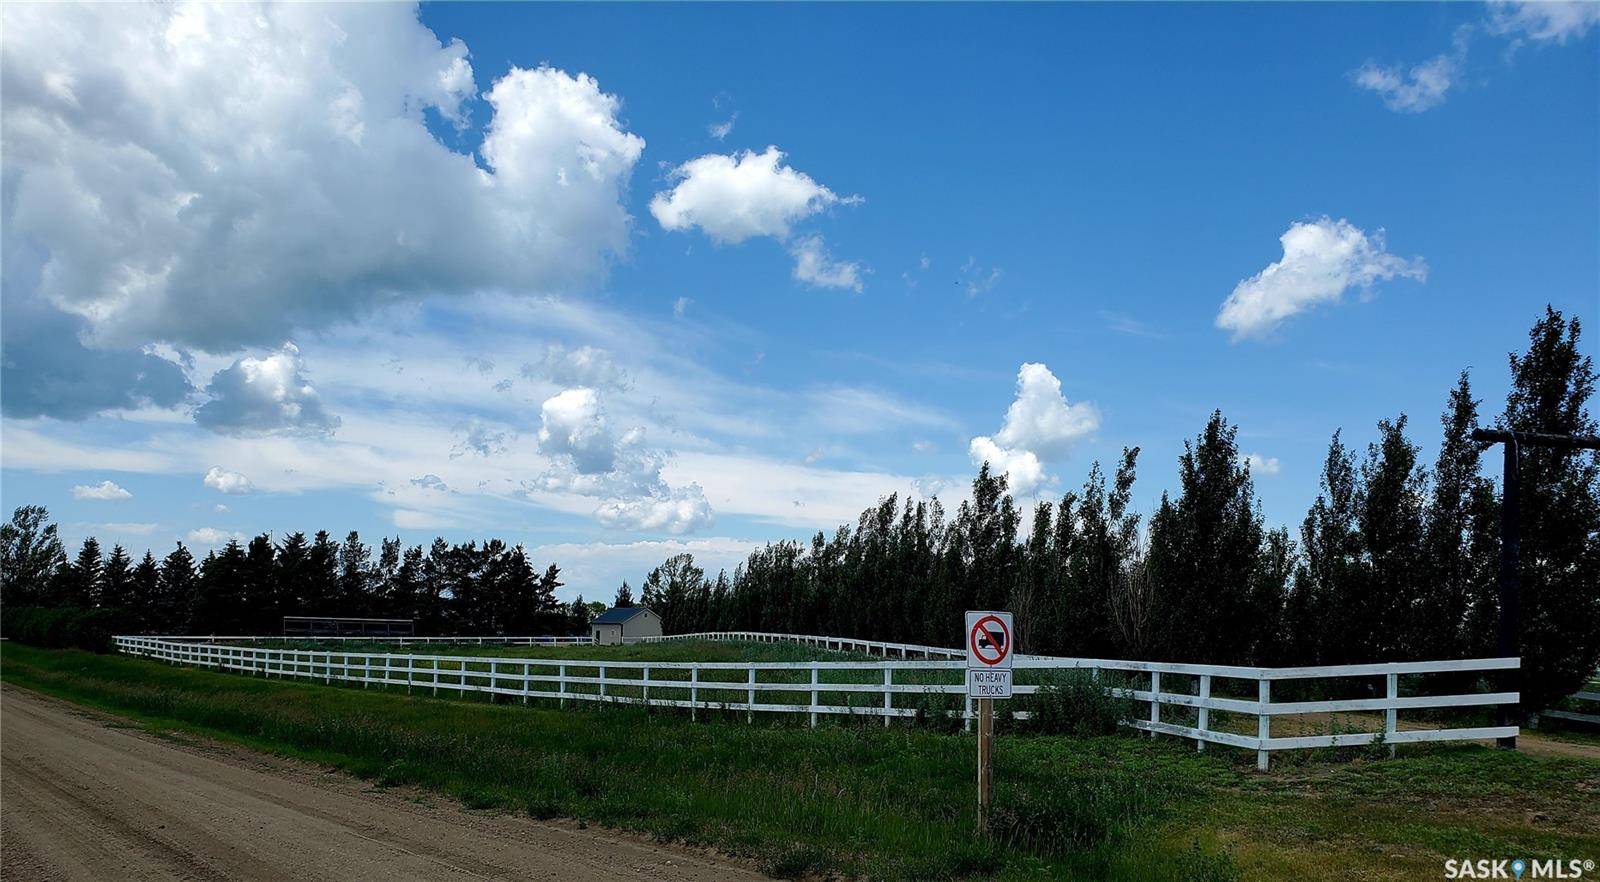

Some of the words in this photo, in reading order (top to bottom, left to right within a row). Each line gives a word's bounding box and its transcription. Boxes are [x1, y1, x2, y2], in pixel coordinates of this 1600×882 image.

[974, 673, 984, 682] NO
[986, 673, 1007, 683] HEAVY
[978, 685, 1004, 695] TRUCKS
